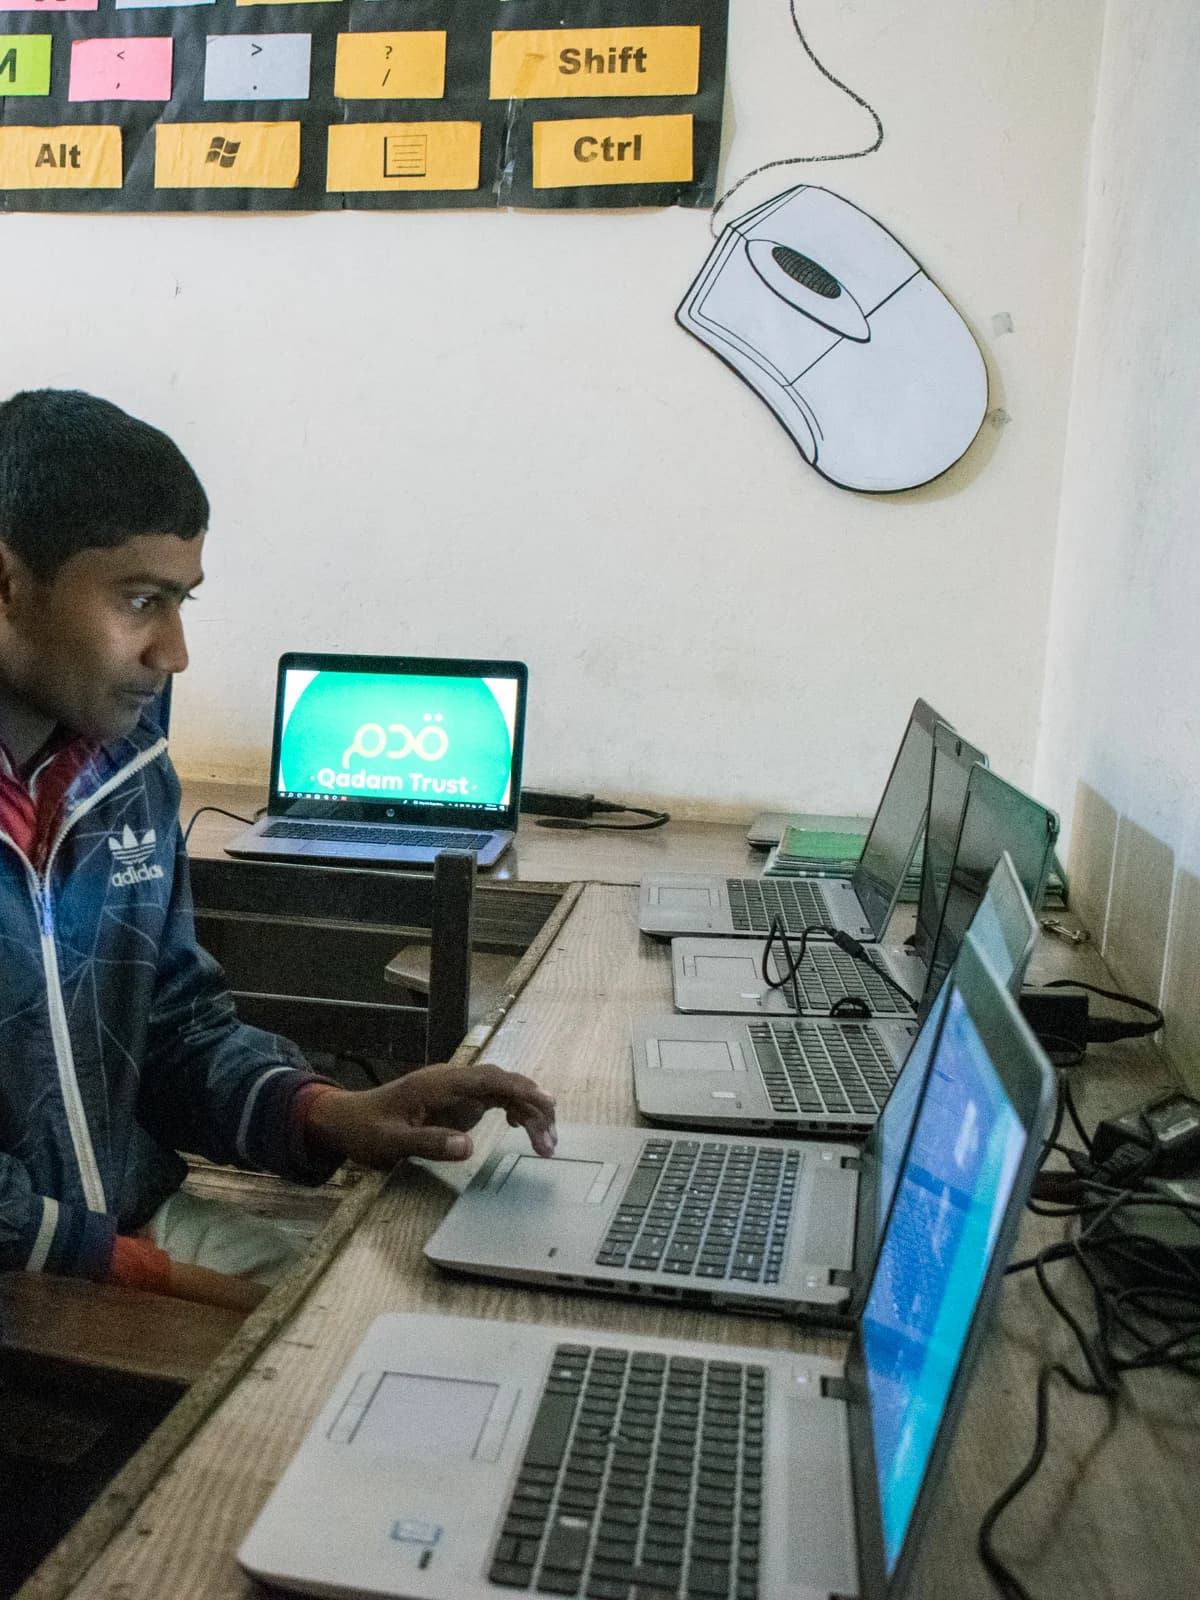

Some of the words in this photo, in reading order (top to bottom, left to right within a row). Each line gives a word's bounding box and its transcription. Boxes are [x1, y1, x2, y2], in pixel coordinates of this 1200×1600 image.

[558, 46, 648, 75] Shift
[34, 143, 82, 169] Alt
[573, 134, 643, 163] Ctrl
[316, 768, 404, 791] Qadam
[408, 772, 469, 795] Trust
[111, 863, 165, 888] adidas
